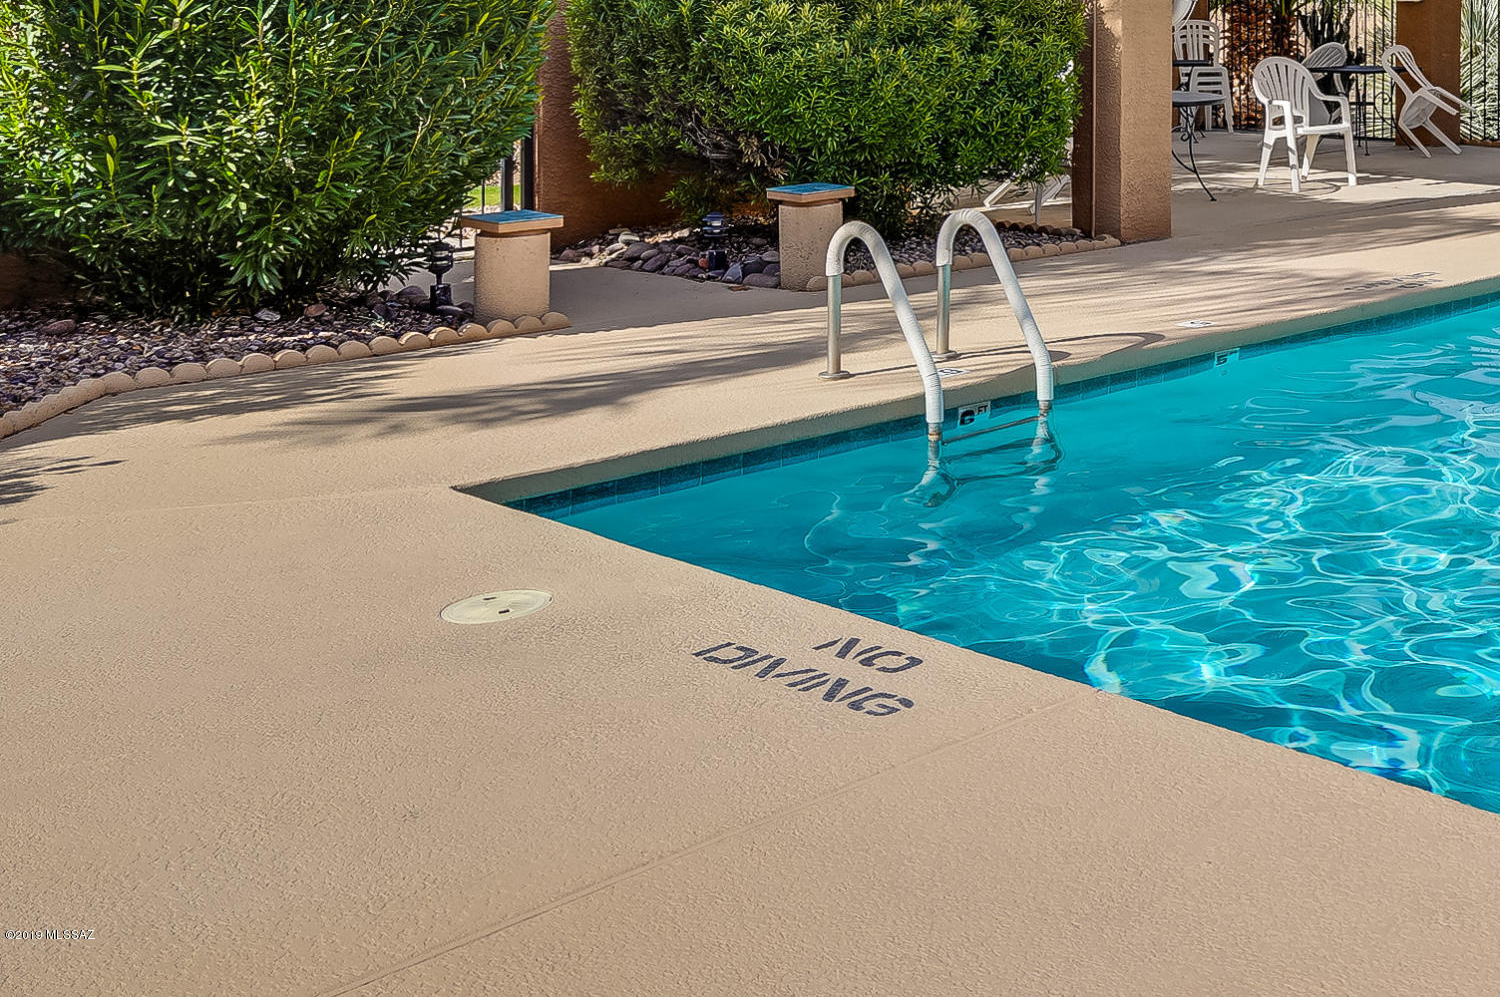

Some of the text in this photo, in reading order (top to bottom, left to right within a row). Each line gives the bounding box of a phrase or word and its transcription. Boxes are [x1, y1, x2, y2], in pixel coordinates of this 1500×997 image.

[1216, 354, 1227, 366] 5
[812, 637, 924, 673] NO
[692, 641, 915, 716] DIVING
